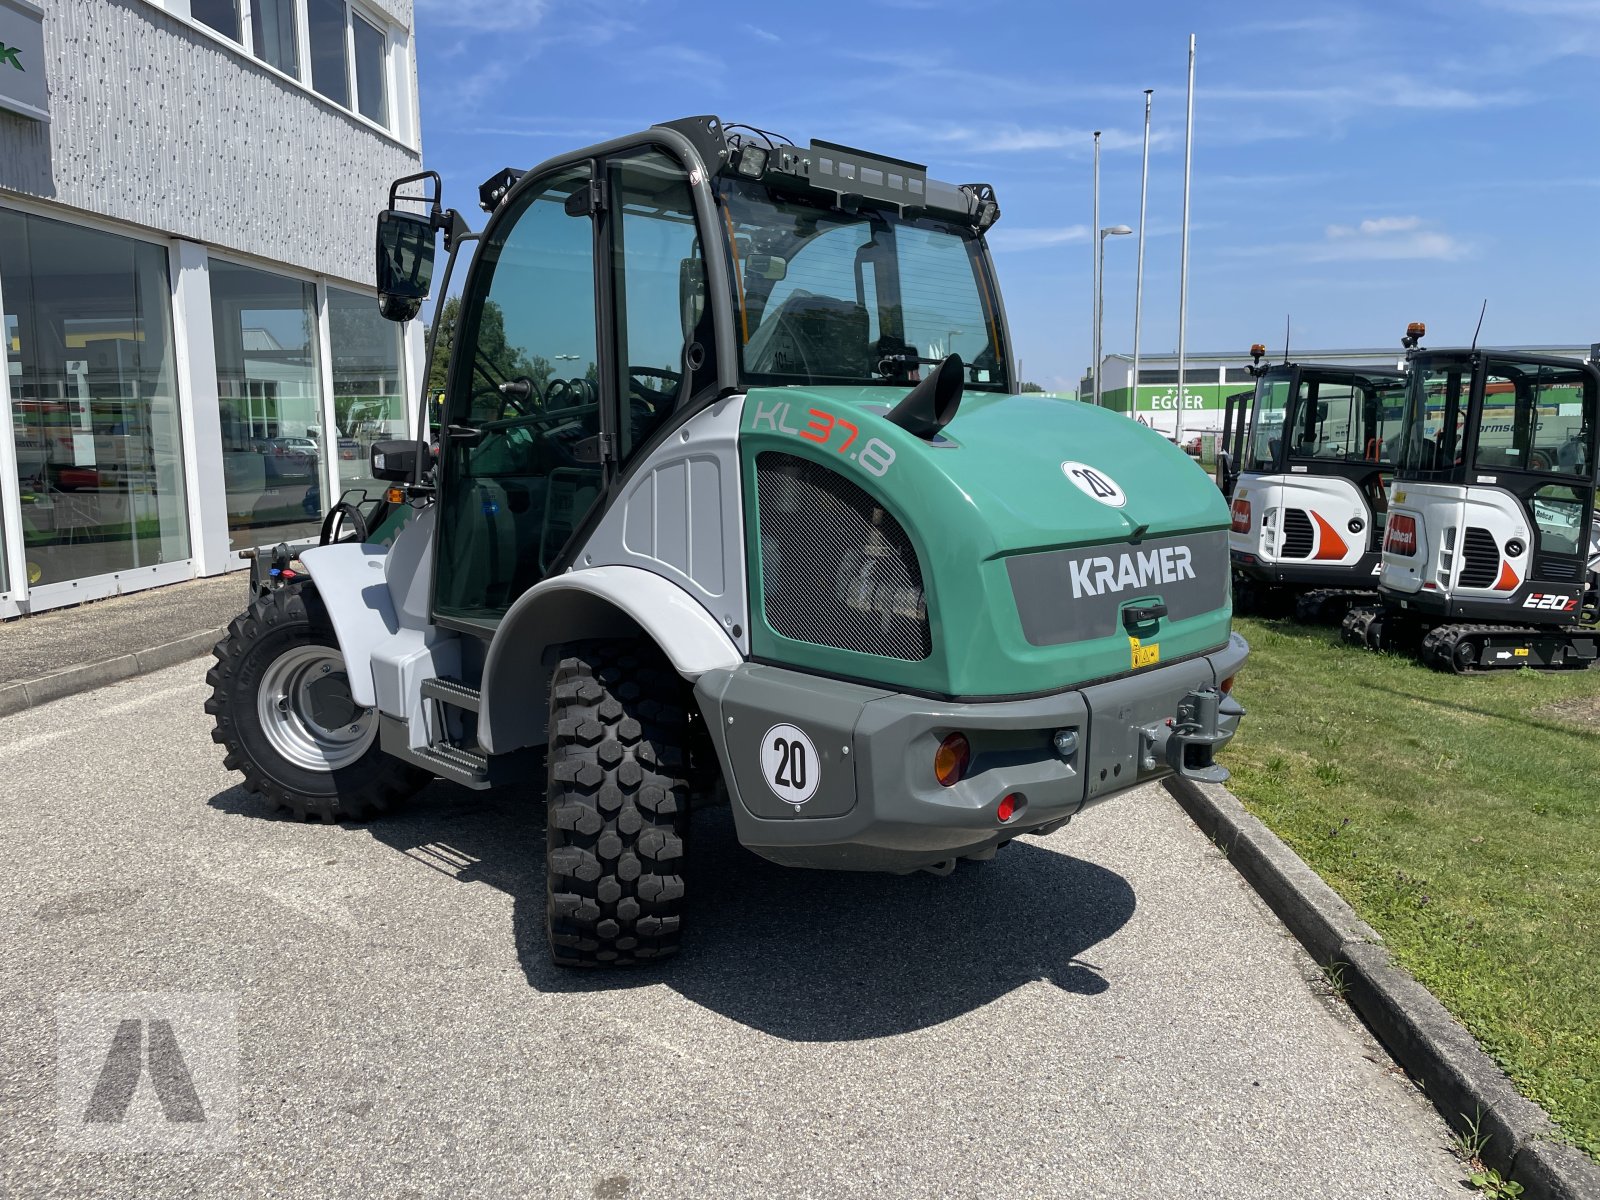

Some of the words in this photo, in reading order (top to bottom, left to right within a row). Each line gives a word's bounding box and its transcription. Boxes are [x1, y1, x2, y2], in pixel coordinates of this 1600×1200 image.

[1072, 469, 1116, 497] 20
[1390, 528, 1413, 543] Bobcat
[1069, 545, 1196, 599] KRAMER
[773, 737, 806, 789] 20
